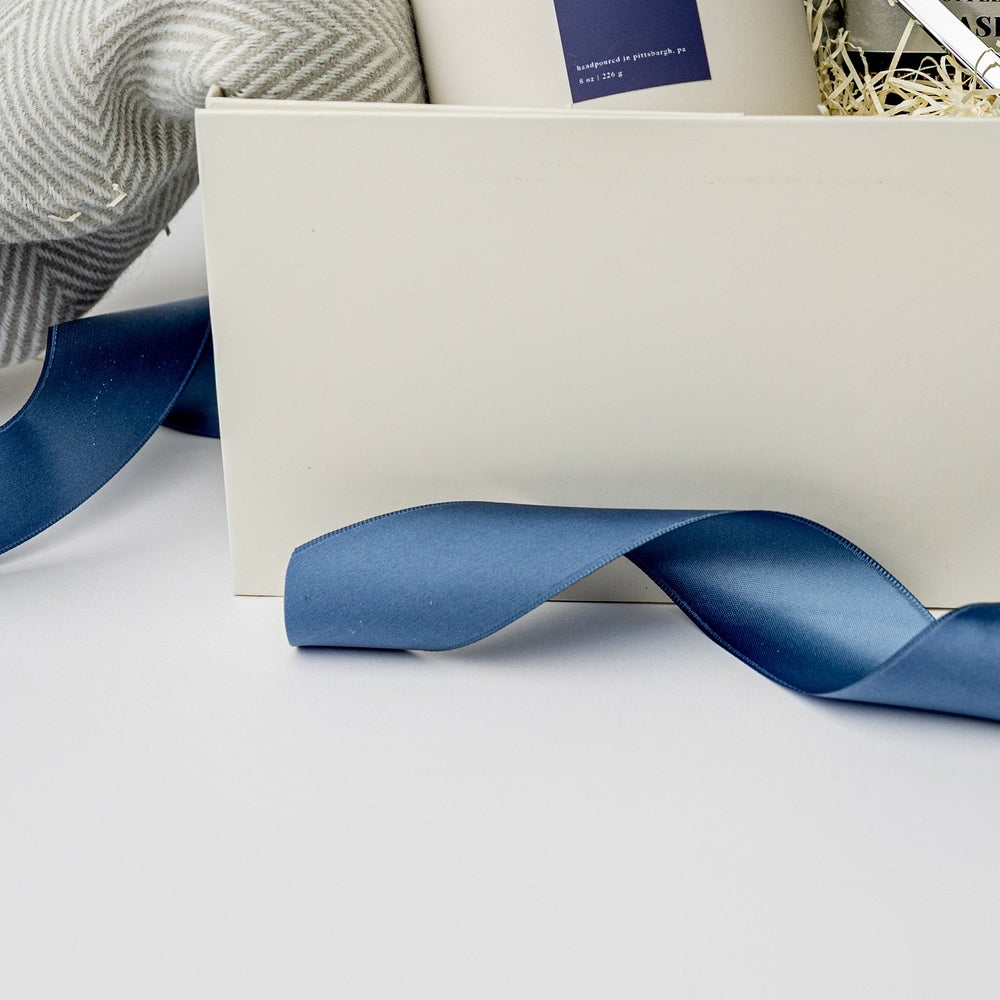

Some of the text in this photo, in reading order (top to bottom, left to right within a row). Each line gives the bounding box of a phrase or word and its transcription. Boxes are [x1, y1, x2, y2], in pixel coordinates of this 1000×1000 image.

[576, 56, 621, 72] handpoured
[622, 55, 631, 63] in
[586, 76, 595, 84] oz
